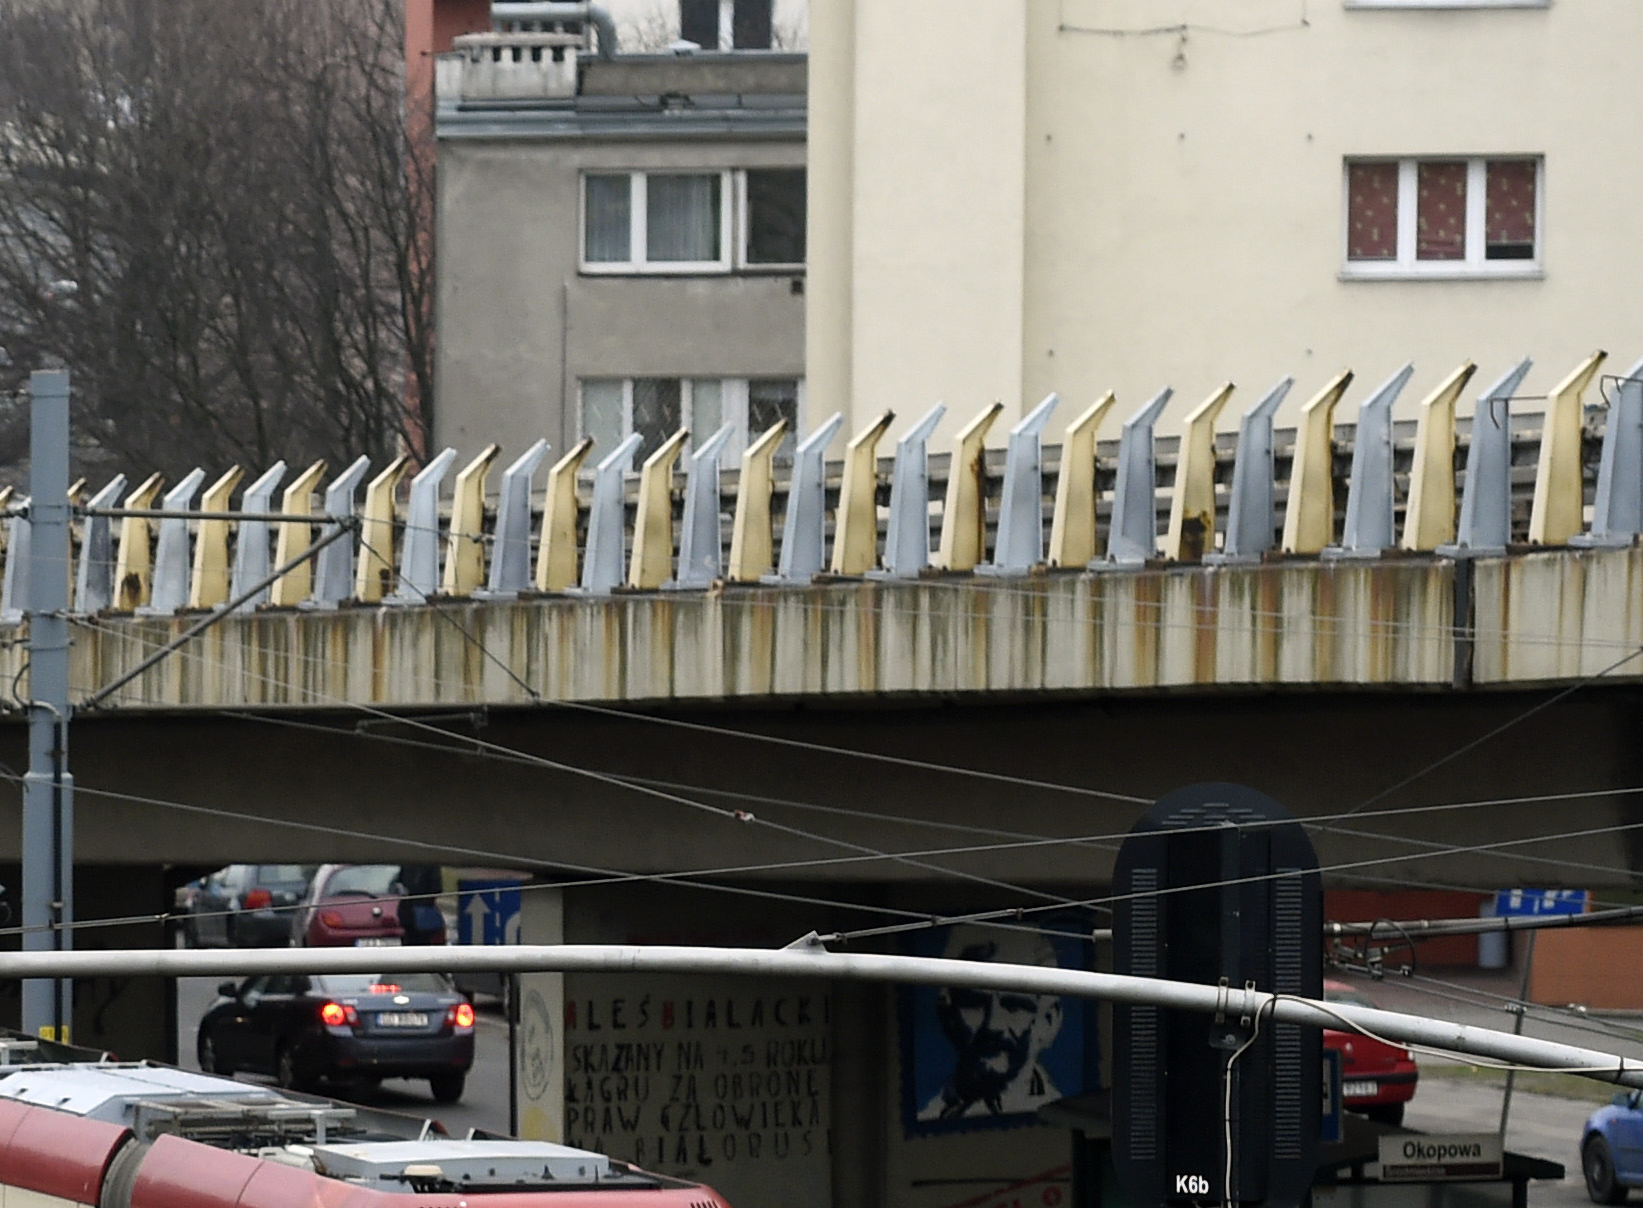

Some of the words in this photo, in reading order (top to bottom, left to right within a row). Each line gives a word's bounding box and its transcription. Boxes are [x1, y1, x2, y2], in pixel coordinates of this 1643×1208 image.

[573, 1041, 665, 1073] SKAZANY
[677, 1041, 704, 1072] NA
[670, 1073, 698, 1105] ZA
[567, 1106, 640, 1135] PRAW
[1403, 1141, 1481, 1160] Okopowa
[1175, 1175, 1209, 1195] K6b
